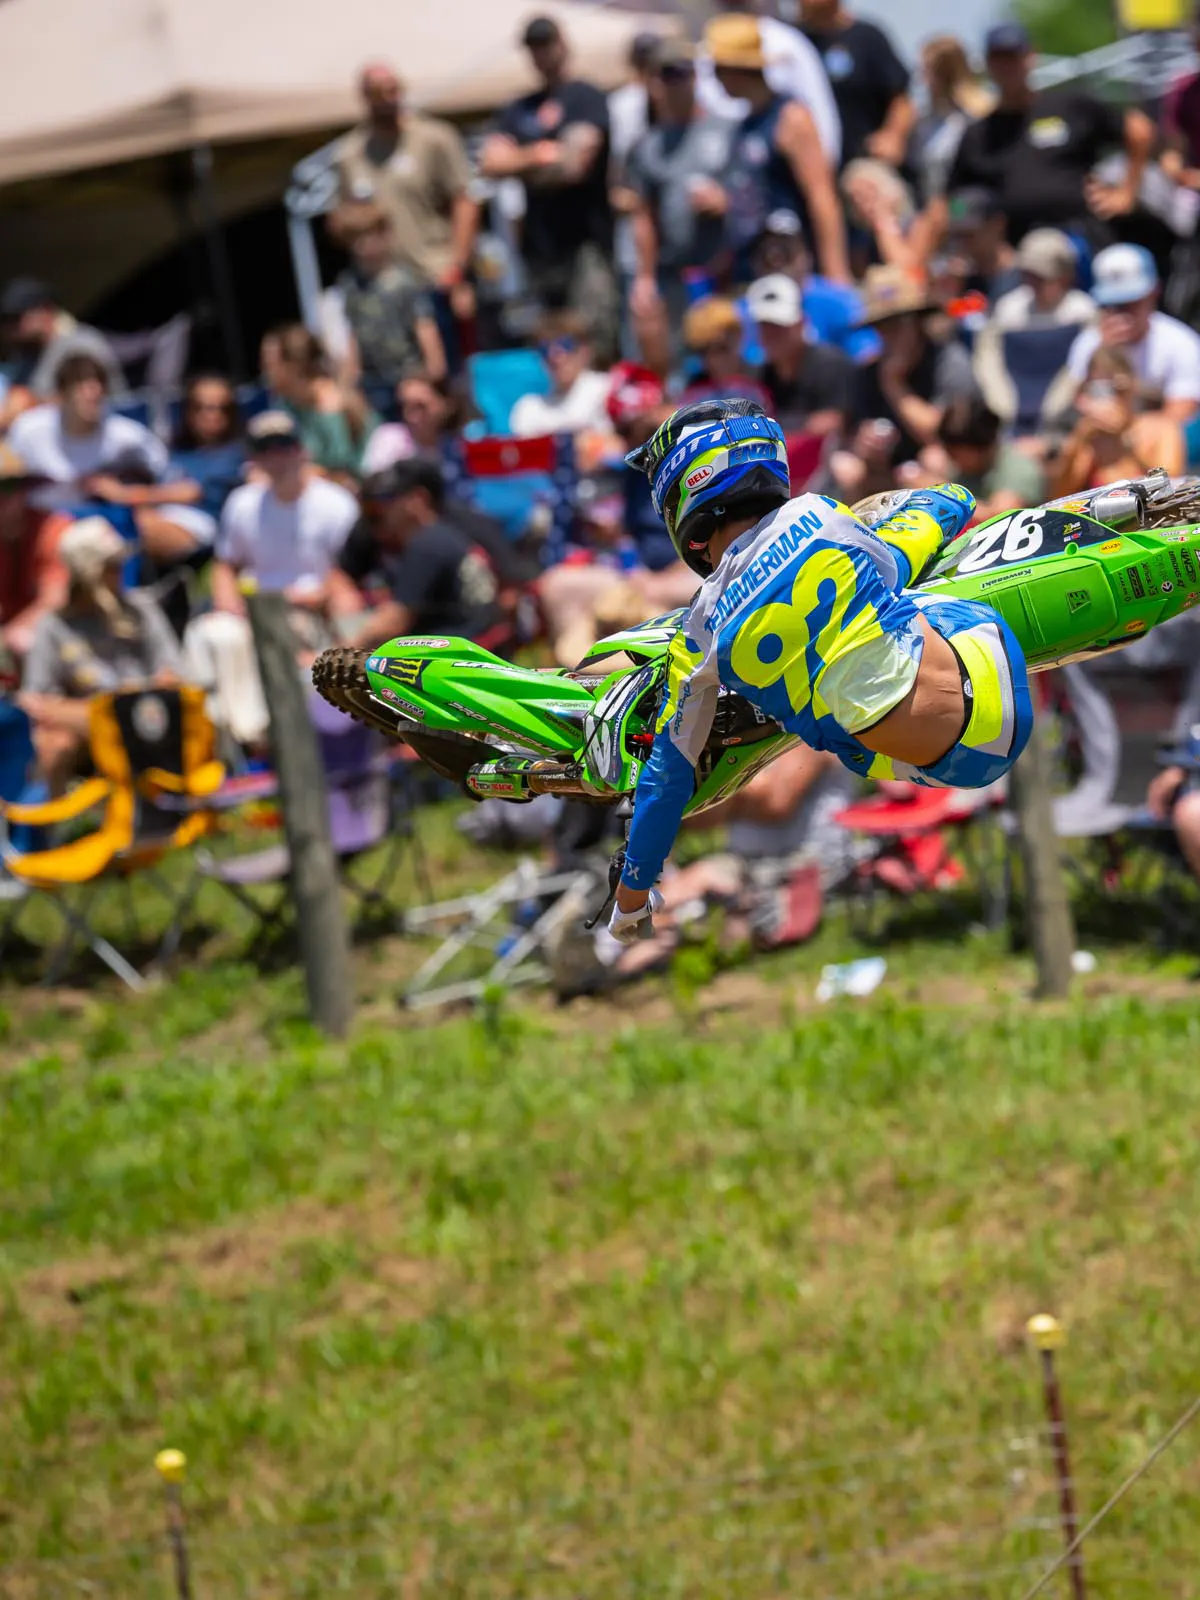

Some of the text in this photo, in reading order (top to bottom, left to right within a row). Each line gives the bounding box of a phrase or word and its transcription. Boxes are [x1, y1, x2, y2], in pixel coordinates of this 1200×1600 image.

[655, 426, 730, 491] SCOTT
[687, 468, 711, 487] BELL
[957, 509, 1047, 573] 26
[981, 568, 1032, 589] Kawasaki
[447, 701, 488, 721] PRO
